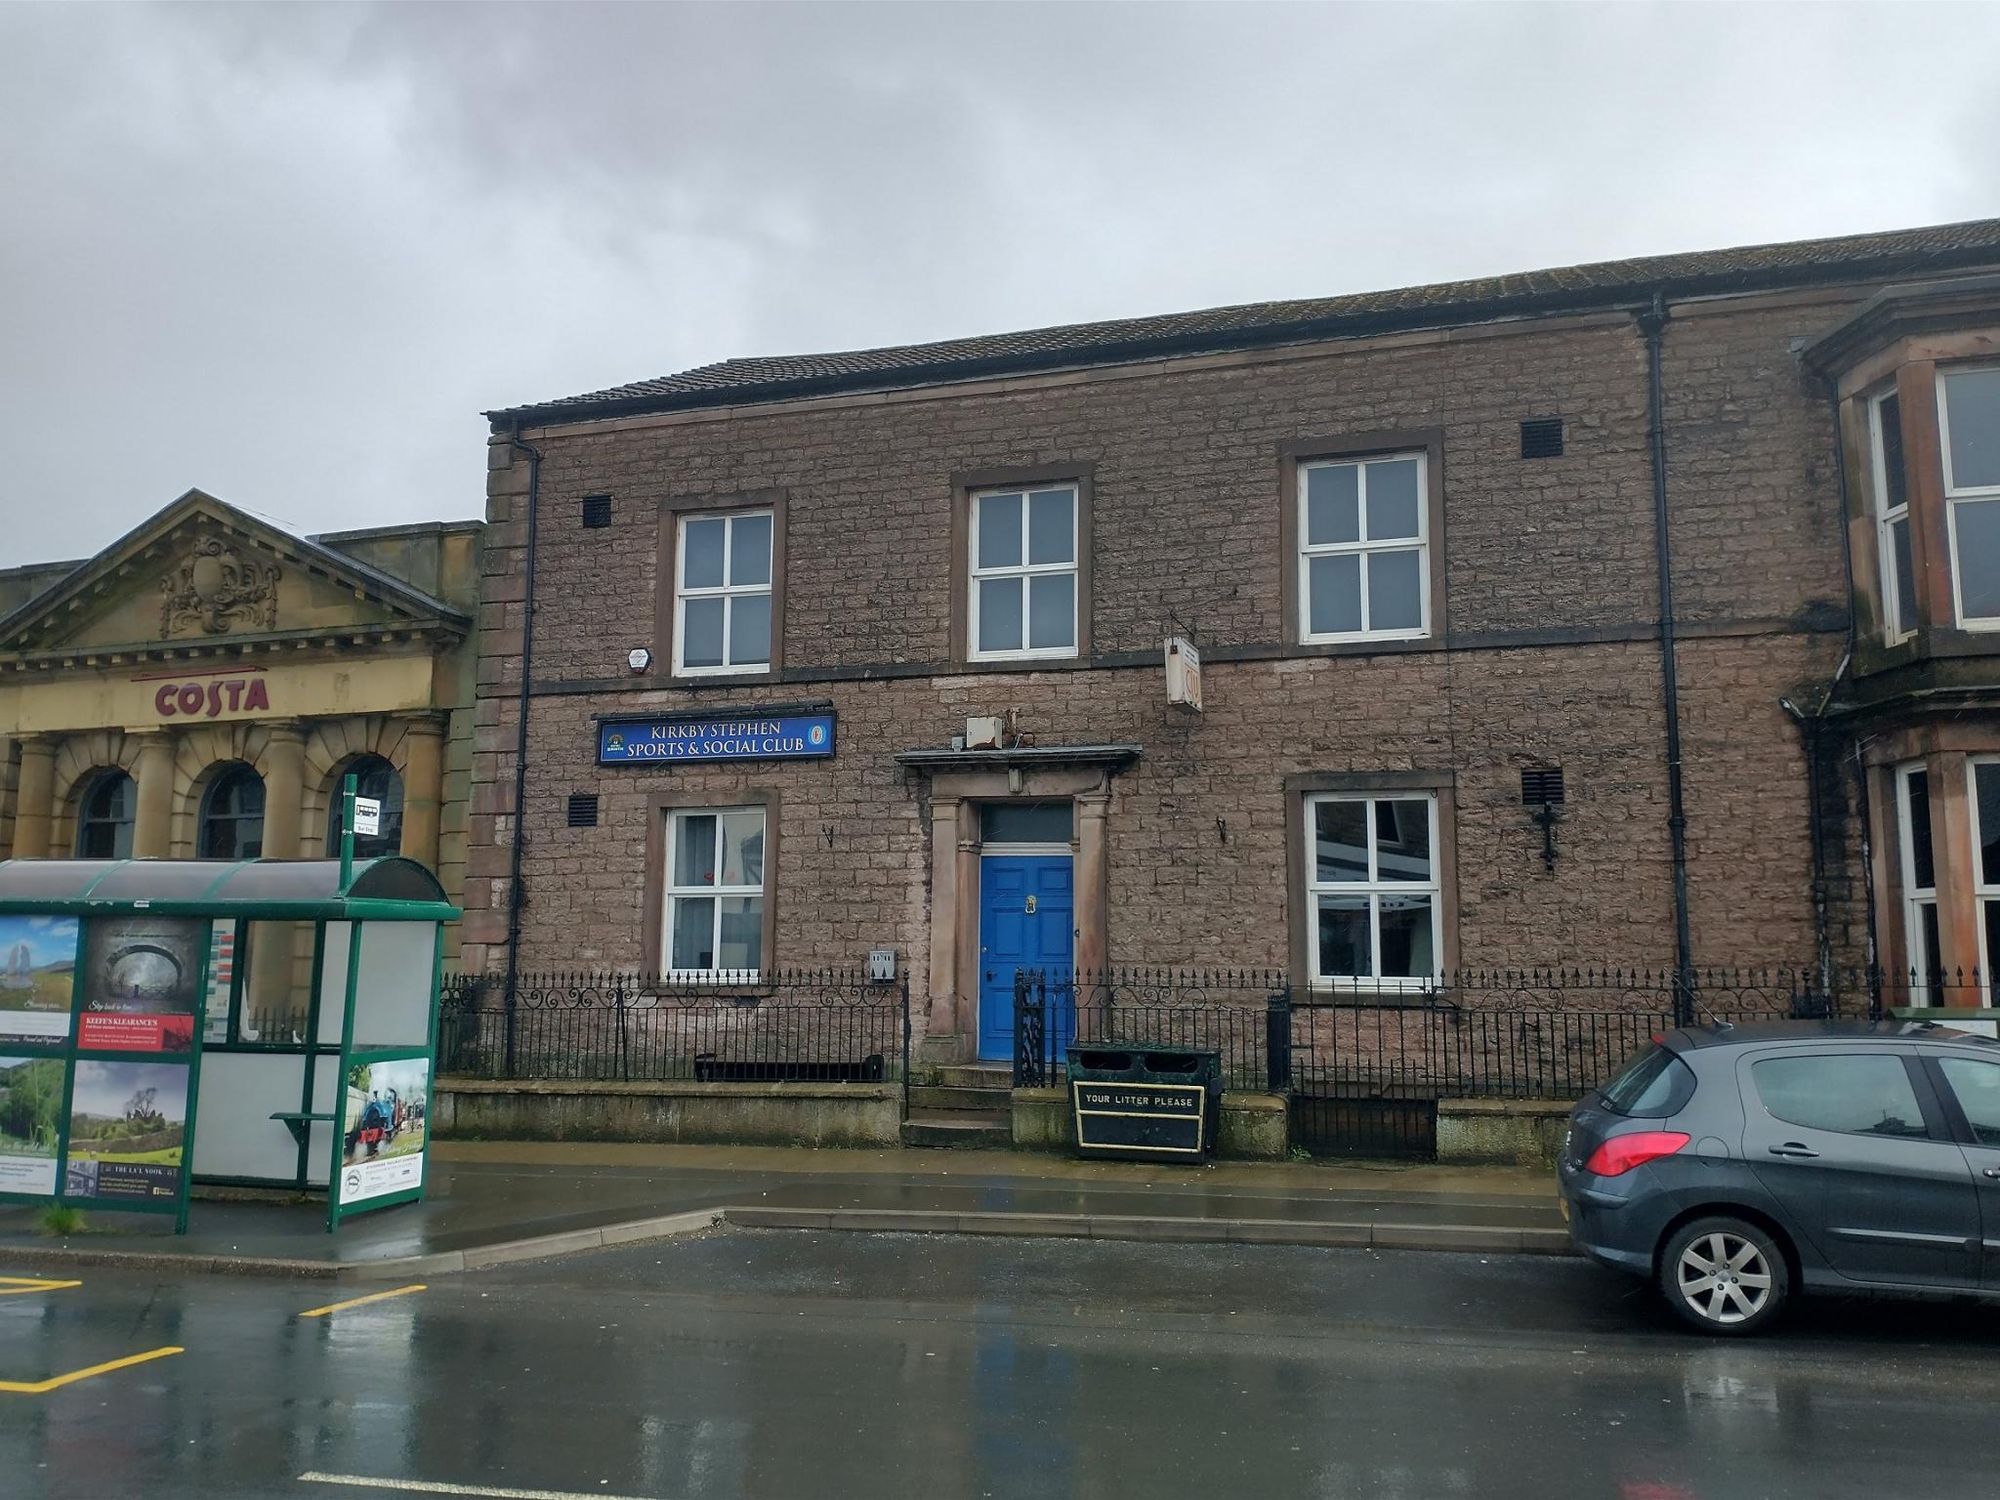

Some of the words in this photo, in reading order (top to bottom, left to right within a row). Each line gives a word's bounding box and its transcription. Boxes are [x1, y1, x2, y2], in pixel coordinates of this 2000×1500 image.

[155, 678, 270, 717] COSTA
[651, 725, 705, 739] KIRKBY
[711, 722, 781, 737] STEPHEN
[627, 742, 684, 757] SPORTS
[687, 742, 700, 755] &
[703, 739, 759, 755] SOCIAL
[762, 738, 804, 752] CLUB
[1086, 1094, 1110, 1103] YOUR
[1115, 1095, 1149, 1105] LITTER
[1154, 1097, 1193, 1107] PLEASE
